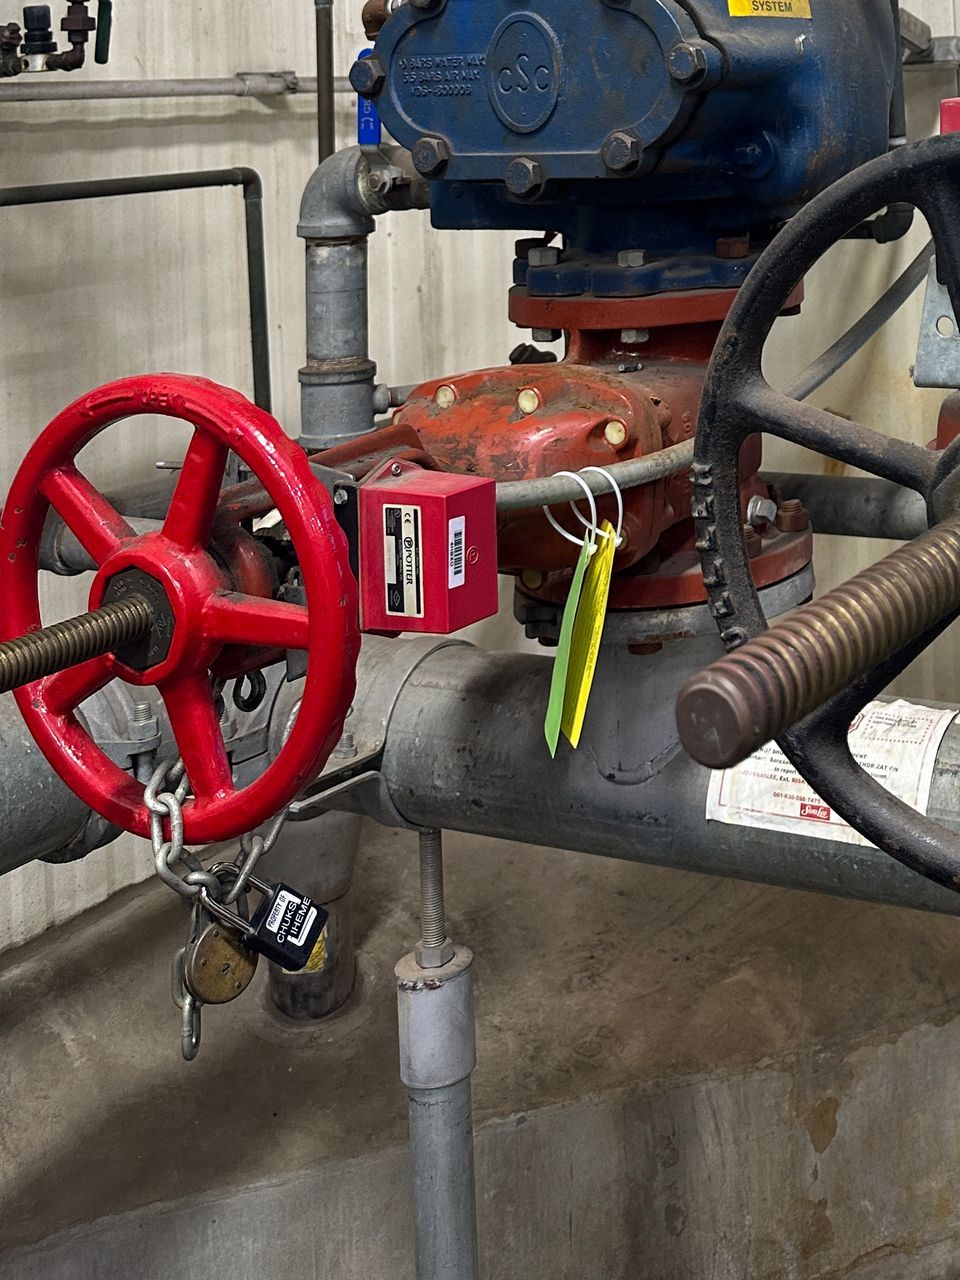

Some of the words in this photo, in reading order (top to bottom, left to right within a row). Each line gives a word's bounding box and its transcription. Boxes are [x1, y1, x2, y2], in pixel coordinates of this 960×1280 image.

[752, 0, 793, 12] SYSTEM
[500, 53, 549, 94] CSC
[405, 549, 413, 585] POTTER
[779, 775, 790, 783] Ext.
[780, 767, 797, 776] report
[277, 901, 297, 943] CHUKS
[291, 896, 312, 935] IHEME
